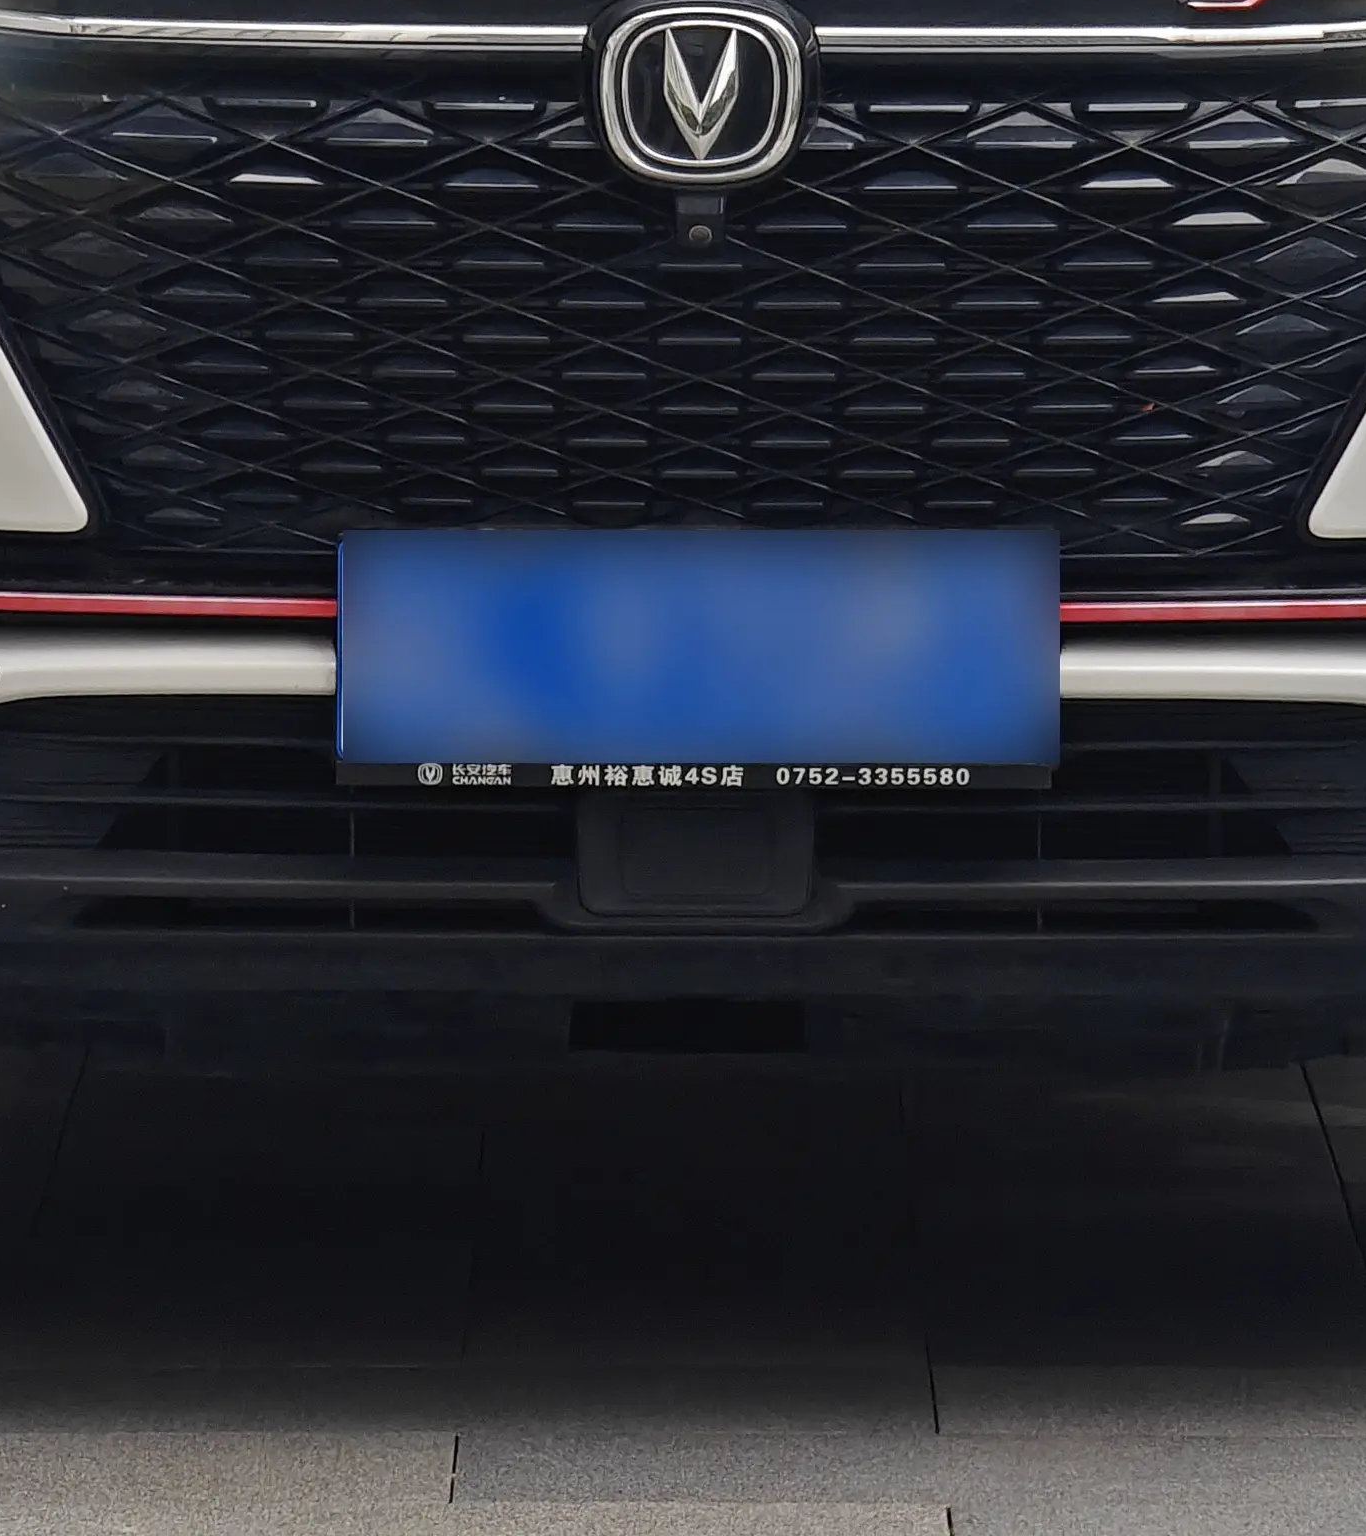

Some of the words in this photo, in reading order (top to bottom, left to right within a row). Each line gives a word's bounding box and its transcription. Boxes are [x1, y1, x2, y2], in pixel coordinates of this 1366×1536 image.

[451, 764, 512, 775] 长安汽车
[451, 775, 512, 786] CHANGAN
[550, 764, 745, 787] 惠州裕惠诚4S店
[775, 767, 971, 786] 0752-3355580
